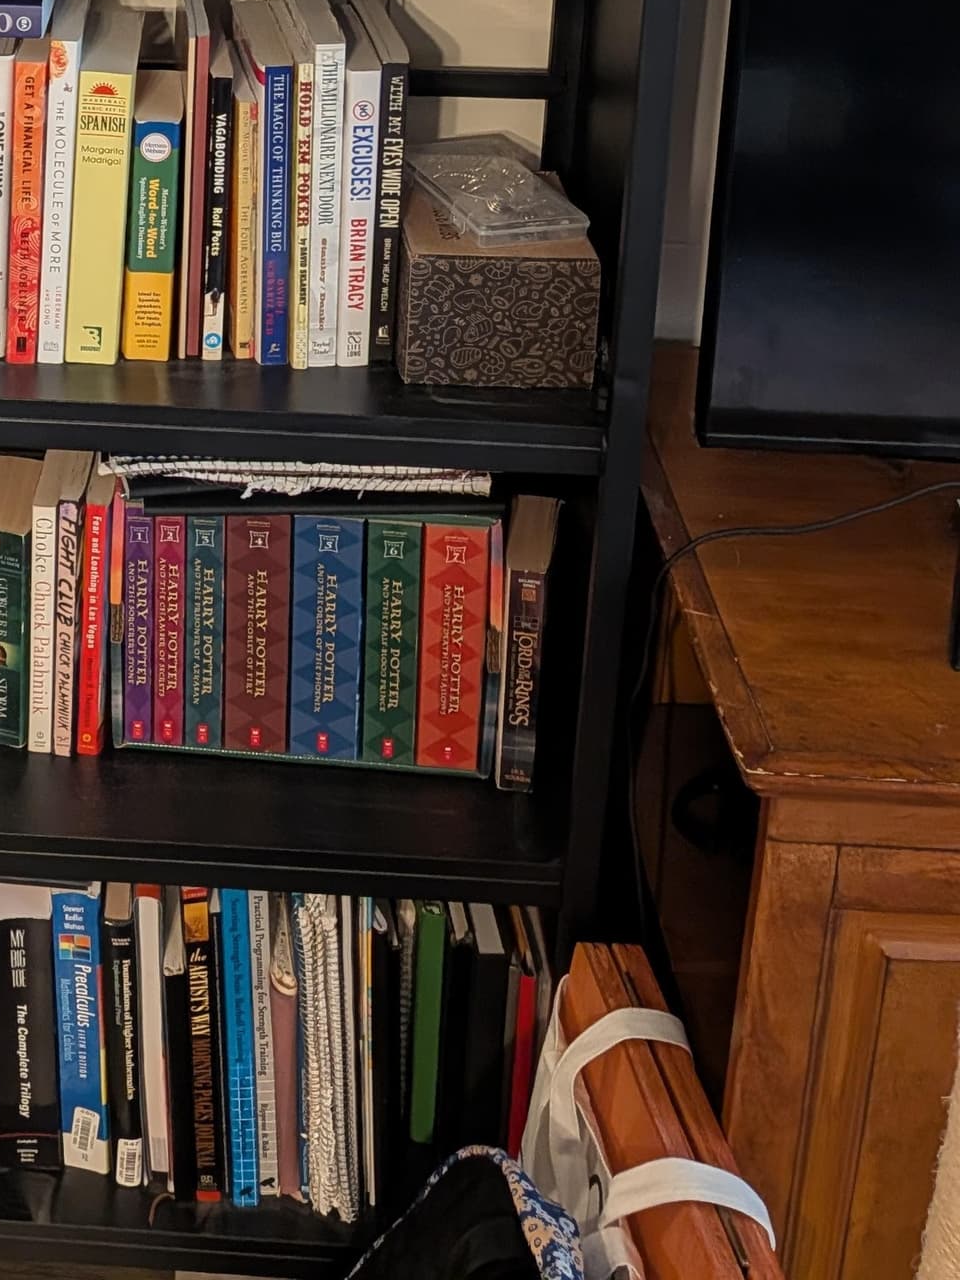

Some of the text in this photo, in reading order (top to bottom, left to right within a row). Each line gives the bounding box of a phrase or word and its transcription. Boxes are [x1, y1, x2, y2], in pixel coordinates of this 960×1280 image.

[80, 114, 126, 134] SPANISH
[212, 113, 226, 194] VAGABONDING
[349, 125, 373, 200] EXCUSES!
[347, 219, 367, 310] BRIAN TRACY
[56, 518, 76, 627] FIGHT CLUB
[135, 560, 148, 685] HARRY POTTER
[323, 575, 337, 703] HARRY POTTER
[448, 586, 464, 713] HARRY POTTER
[74, 964, 94, 1027] Precalculus
[189, 947, 207, 962] the
[189, 965, 209, 1035] ARTIST'S WAY
[15, 1004, 32, 1117] The Complete Trilogy
